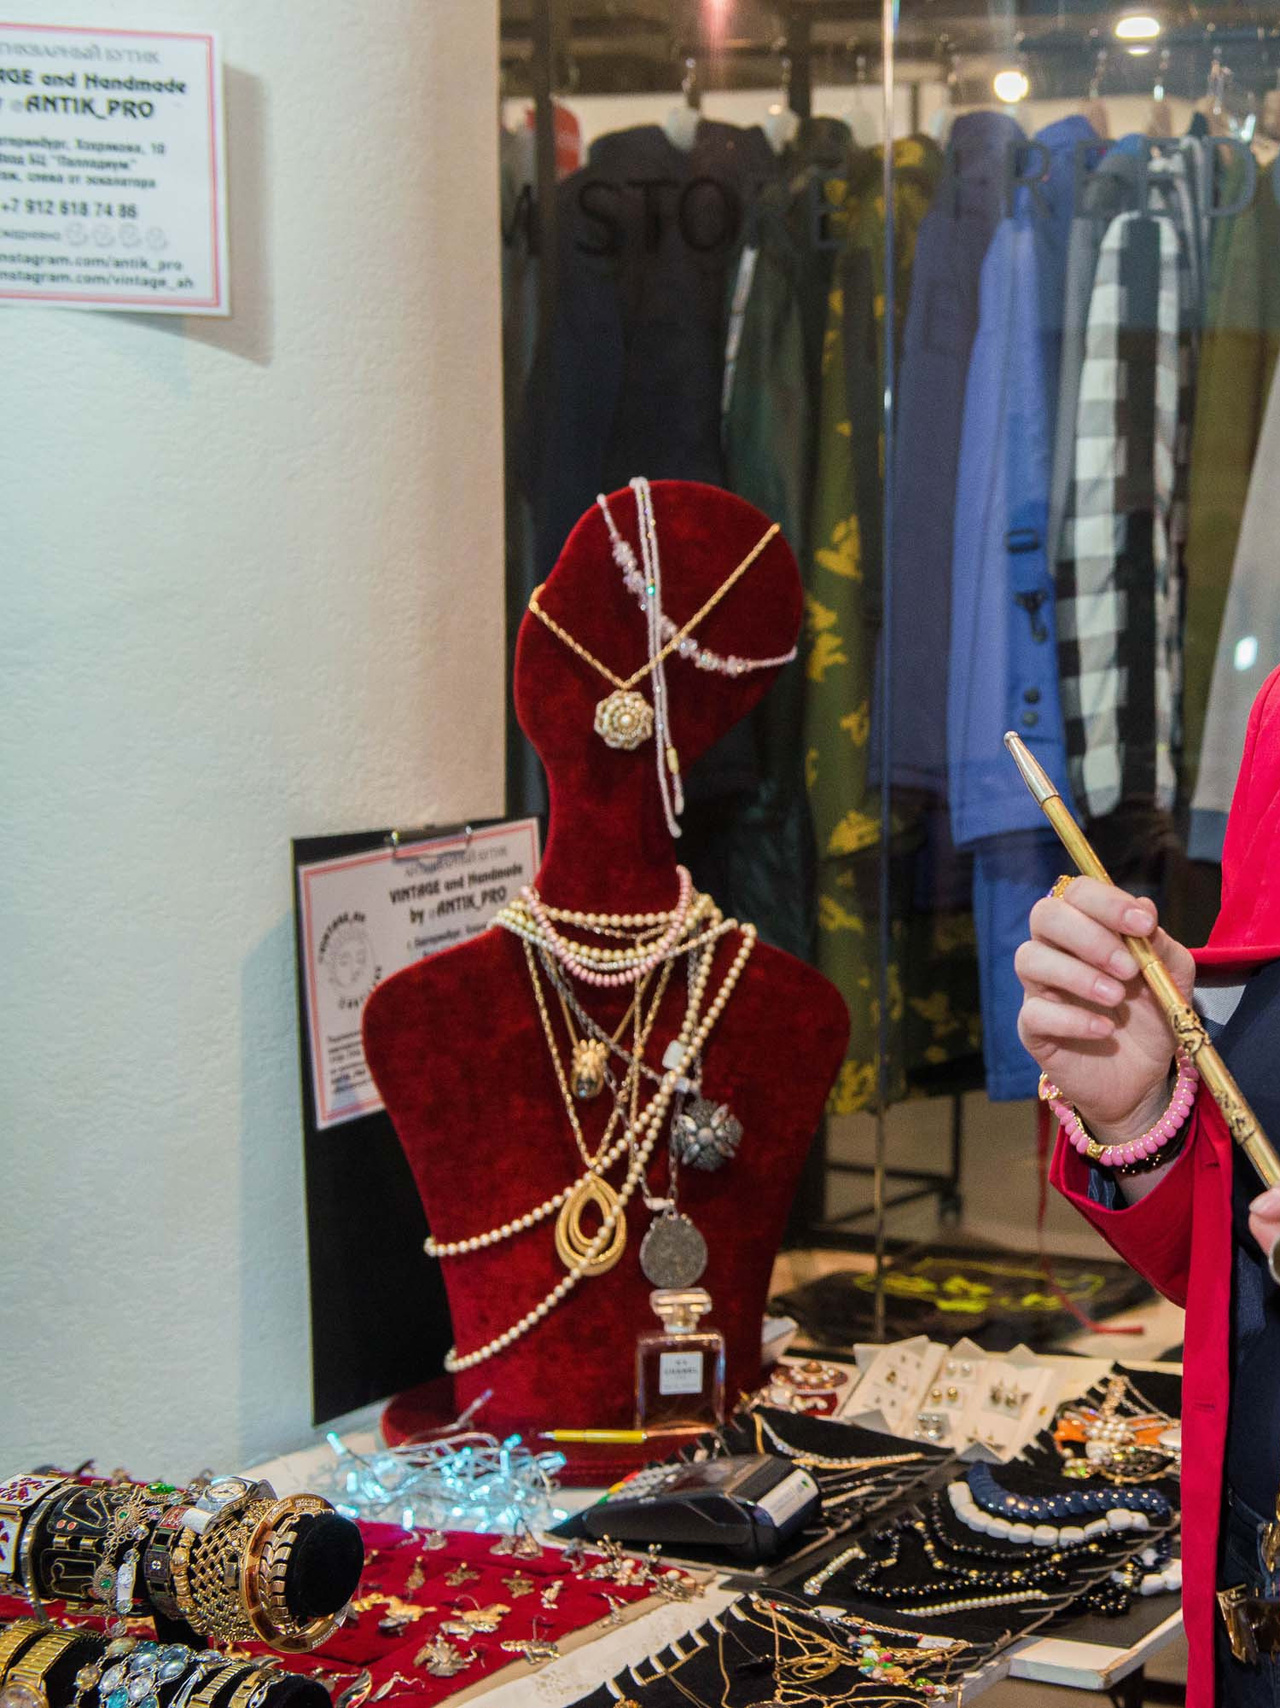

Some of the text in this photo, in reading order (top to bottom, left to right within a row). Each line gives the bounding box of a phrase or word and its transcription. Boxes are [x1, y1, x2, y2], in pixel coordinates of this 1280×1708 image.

[41, 71, 76, 88] and
[84, 73, 187, 94] Handmade
[389, 879, 440, 905] VINTAGE
[444, 875, 464, 892] and
[467, 862, 523, 886] Handmade
[409, 908, 425, 924] by
